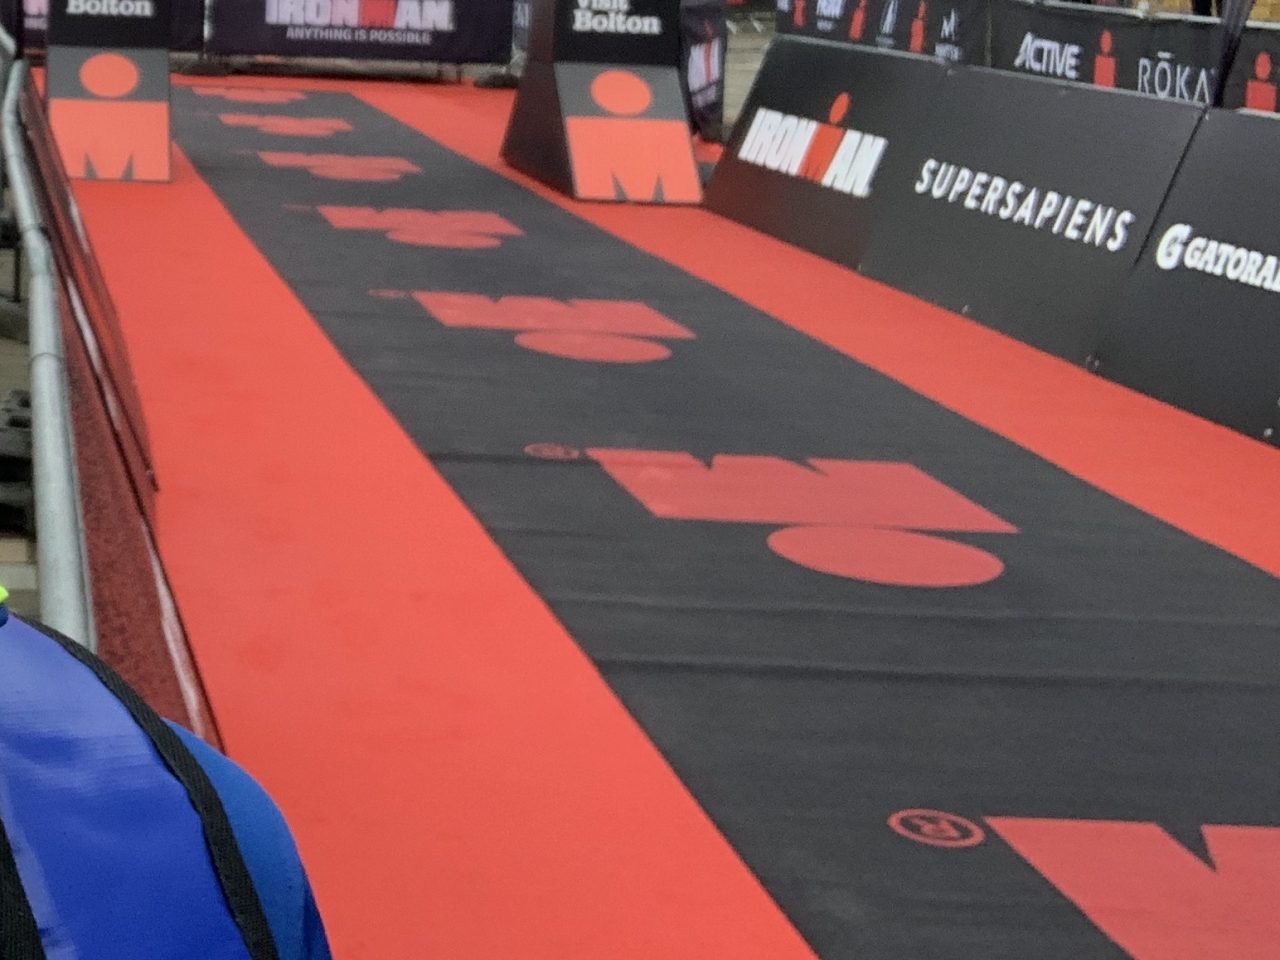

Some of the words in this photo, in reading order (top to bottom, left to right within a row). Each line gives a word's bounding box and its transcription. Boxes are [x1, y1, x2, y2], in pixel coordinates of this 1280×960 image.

[285, 25, 352, 41] ANYTHING
[354, 27, 367, 41] IS
[369, 28, 432, 45] POSSIBLE
[572, 8, 662, 35] Bolton
[1014, 31, 1082, 80] ACTIVE
[738, 92, 889, 199] IRONMAN
[915, 157, 1137, 253] SUPERSAPIENS
[1184, 236, 1280, 294] GATORA
